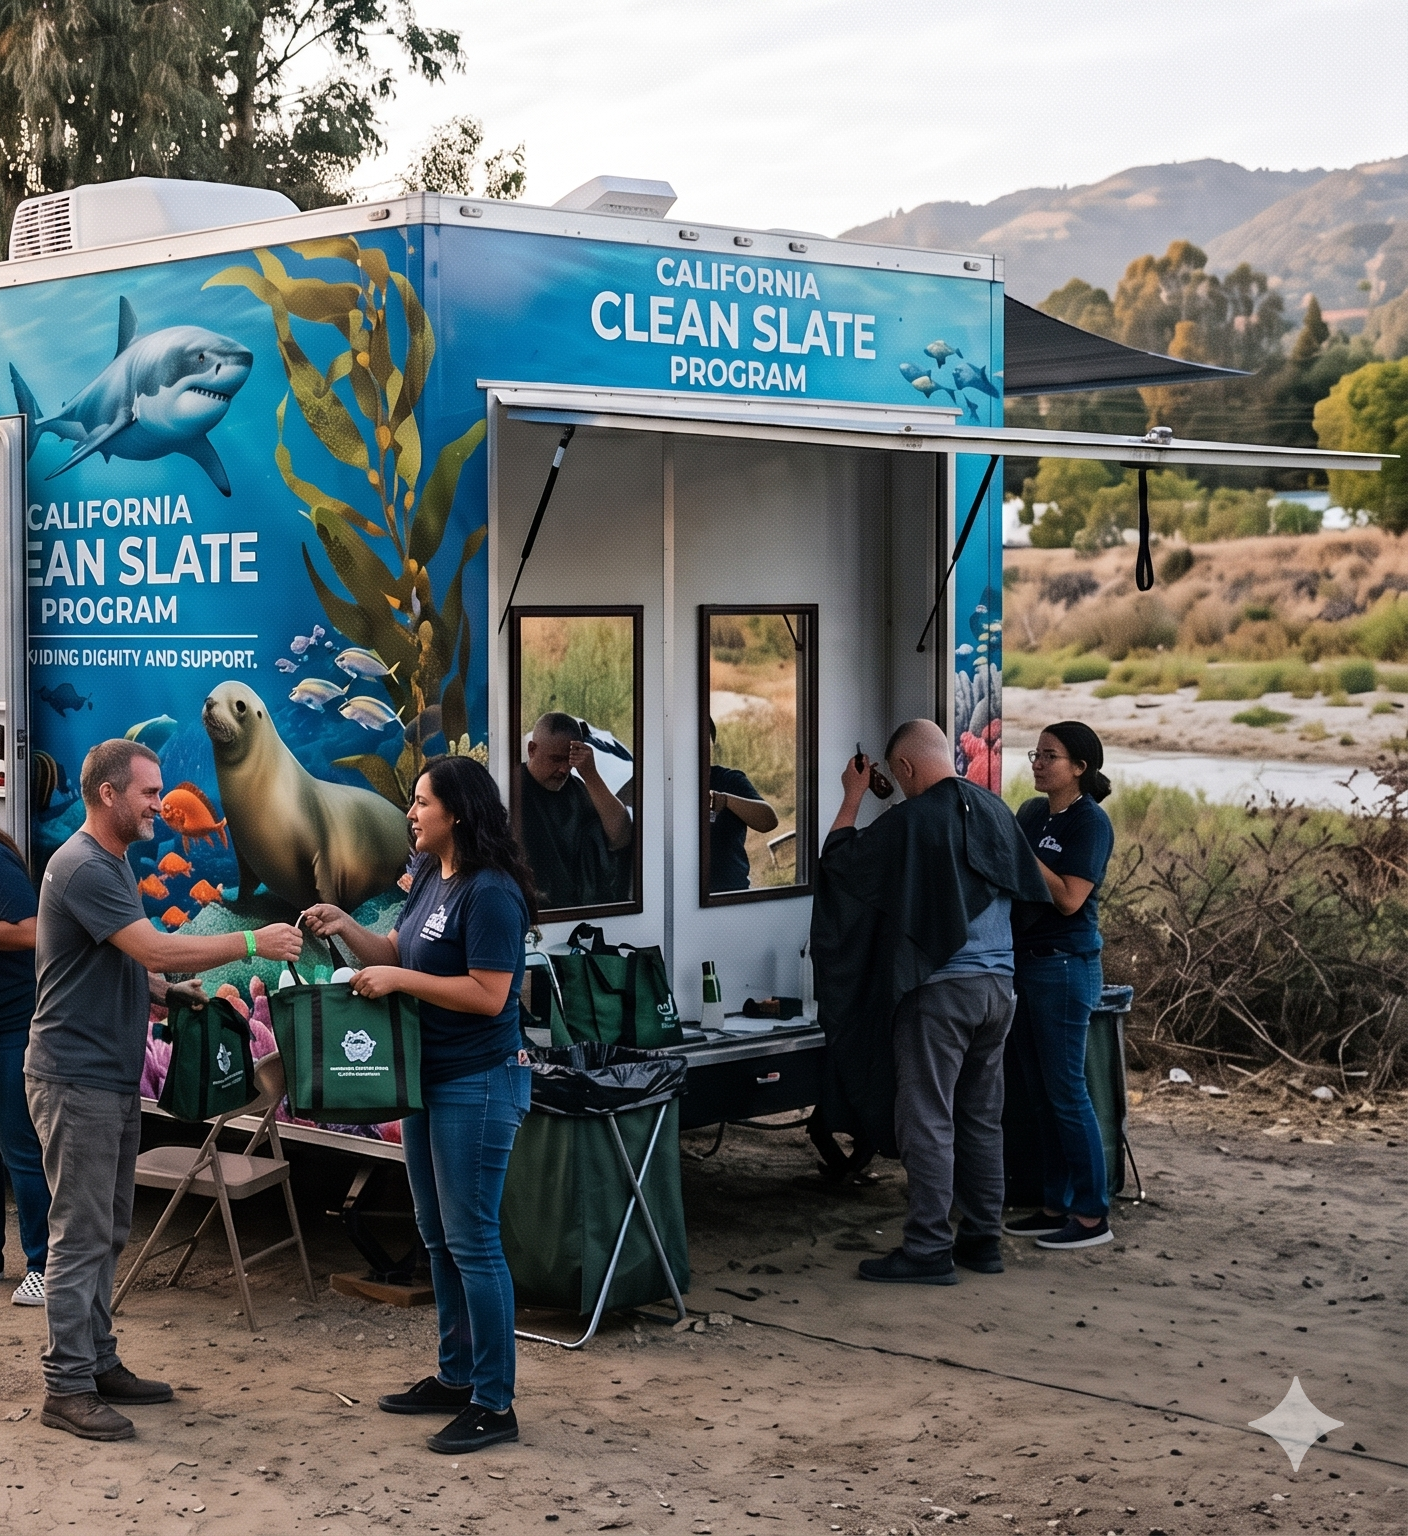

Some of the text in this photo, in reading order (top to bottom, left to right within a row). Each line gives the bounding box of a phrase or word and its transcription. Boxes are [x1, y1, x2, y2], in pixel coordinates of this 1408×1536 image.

[656, 257, 820, 300] CALIFORNIA
[591, 290, 877, 359] CLEAN SLATE
[670, 355, 806, 392] PROGRAM
[29, 495, 193, 531] CALIFORNIA
[28, 531, 259, 587] EAN SLATE
[41, 595, 178, 626] PROGRAM
[144, 650, 178, 667] AND
[180, 650, 258, 669] SUPPORT.
